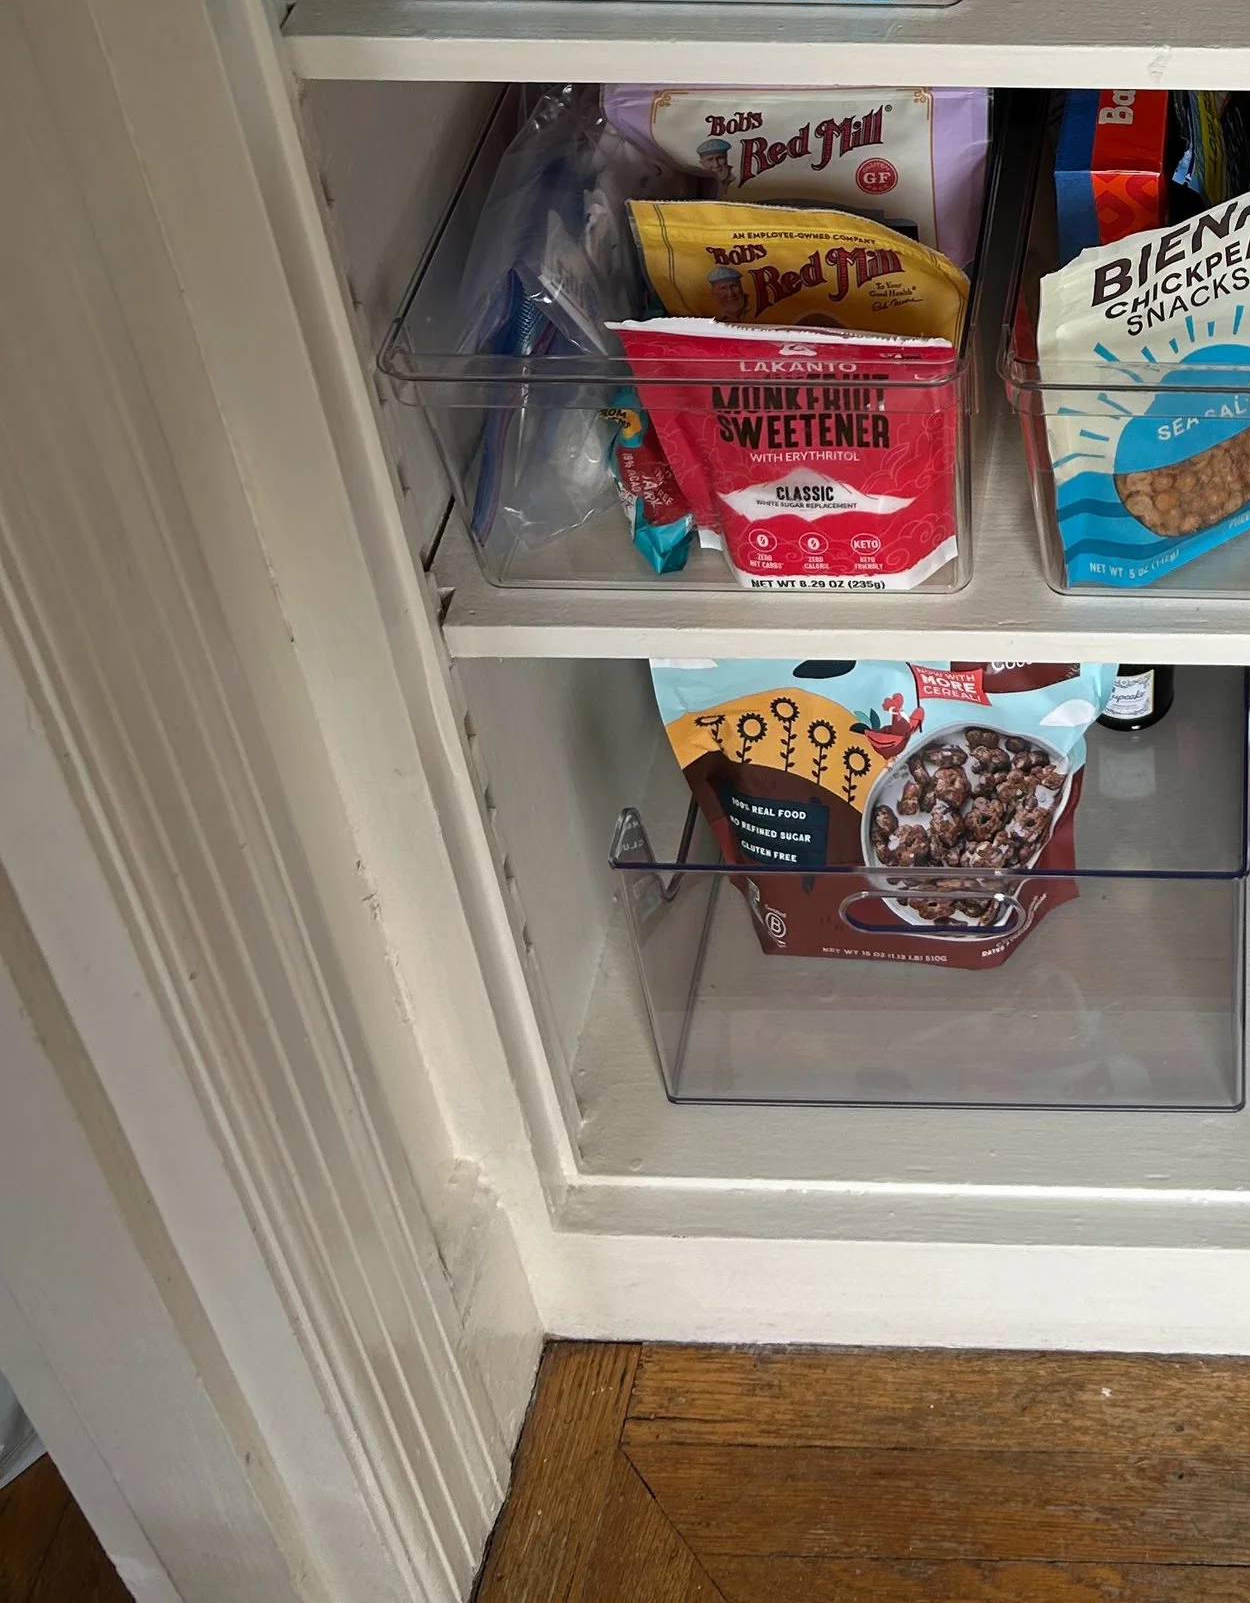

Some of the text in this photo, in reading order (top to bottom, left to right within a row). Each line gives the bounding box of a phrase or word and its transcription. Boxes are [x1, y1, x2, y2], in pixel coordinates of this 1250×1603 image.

[705, 111, 763, 137] Bob's
[738, 105, 884, 188] Red Mill
[747, 232, 831, 241] EMPLOYEE-OWNED
[833, 234, 876, 244] COMPANY
[705, 244, 768, 265] Bob's
[748, 246, 905, 318] Red Mill
[1127, 267, 1250, 337] SNACKS
[739, 360, 857, 373] LAKANTO
[717, 413, 890, 450] SWEETENER
[750, 450, 860, 463] WITH ERYTHRITOL
[776, 486, 834, 502] CLASSIC
[781, 501, 805, 509] SUGAR
[853, 539, 879, 549] KETO
[1089, 562, 1136, 579] NET WT 5
[751, 579, 886, 589] NET WT 8.29 OZ (235g)
[921, 674, 976, 694] MORE
[945, 672, 976, 683] WITH
[923, 685, 982, 702] CEREAL!
[751, 805, 775, 818] REAL
[778, 808, 806, 820] FOOD
[741, 821, 777, 839] REFINED
[780, 831, 811, 843] SUGAR
[741, 840, 797, 863] GLUTEN FREE
